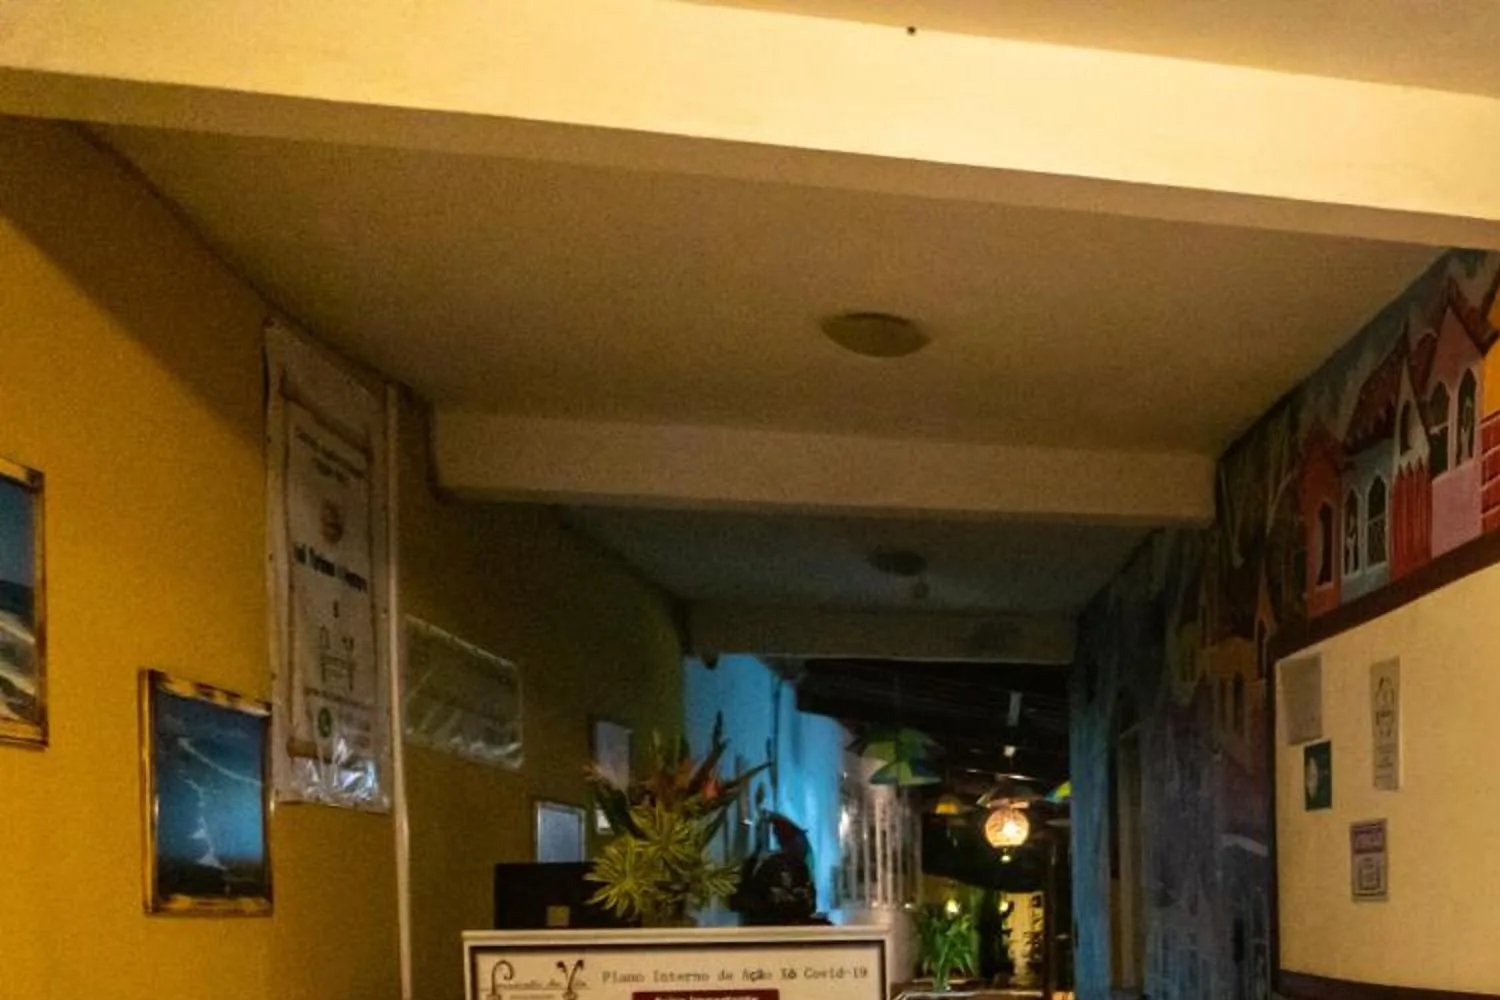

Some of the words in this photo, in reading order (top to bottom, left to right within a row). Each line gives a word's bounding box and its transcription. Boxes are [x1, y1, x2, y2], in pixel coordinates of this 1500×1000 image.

[602, 970, 645, 983] Plano
[653, 969, 710, 983] Interno
[803, 966, 868, 980] Covid-19
